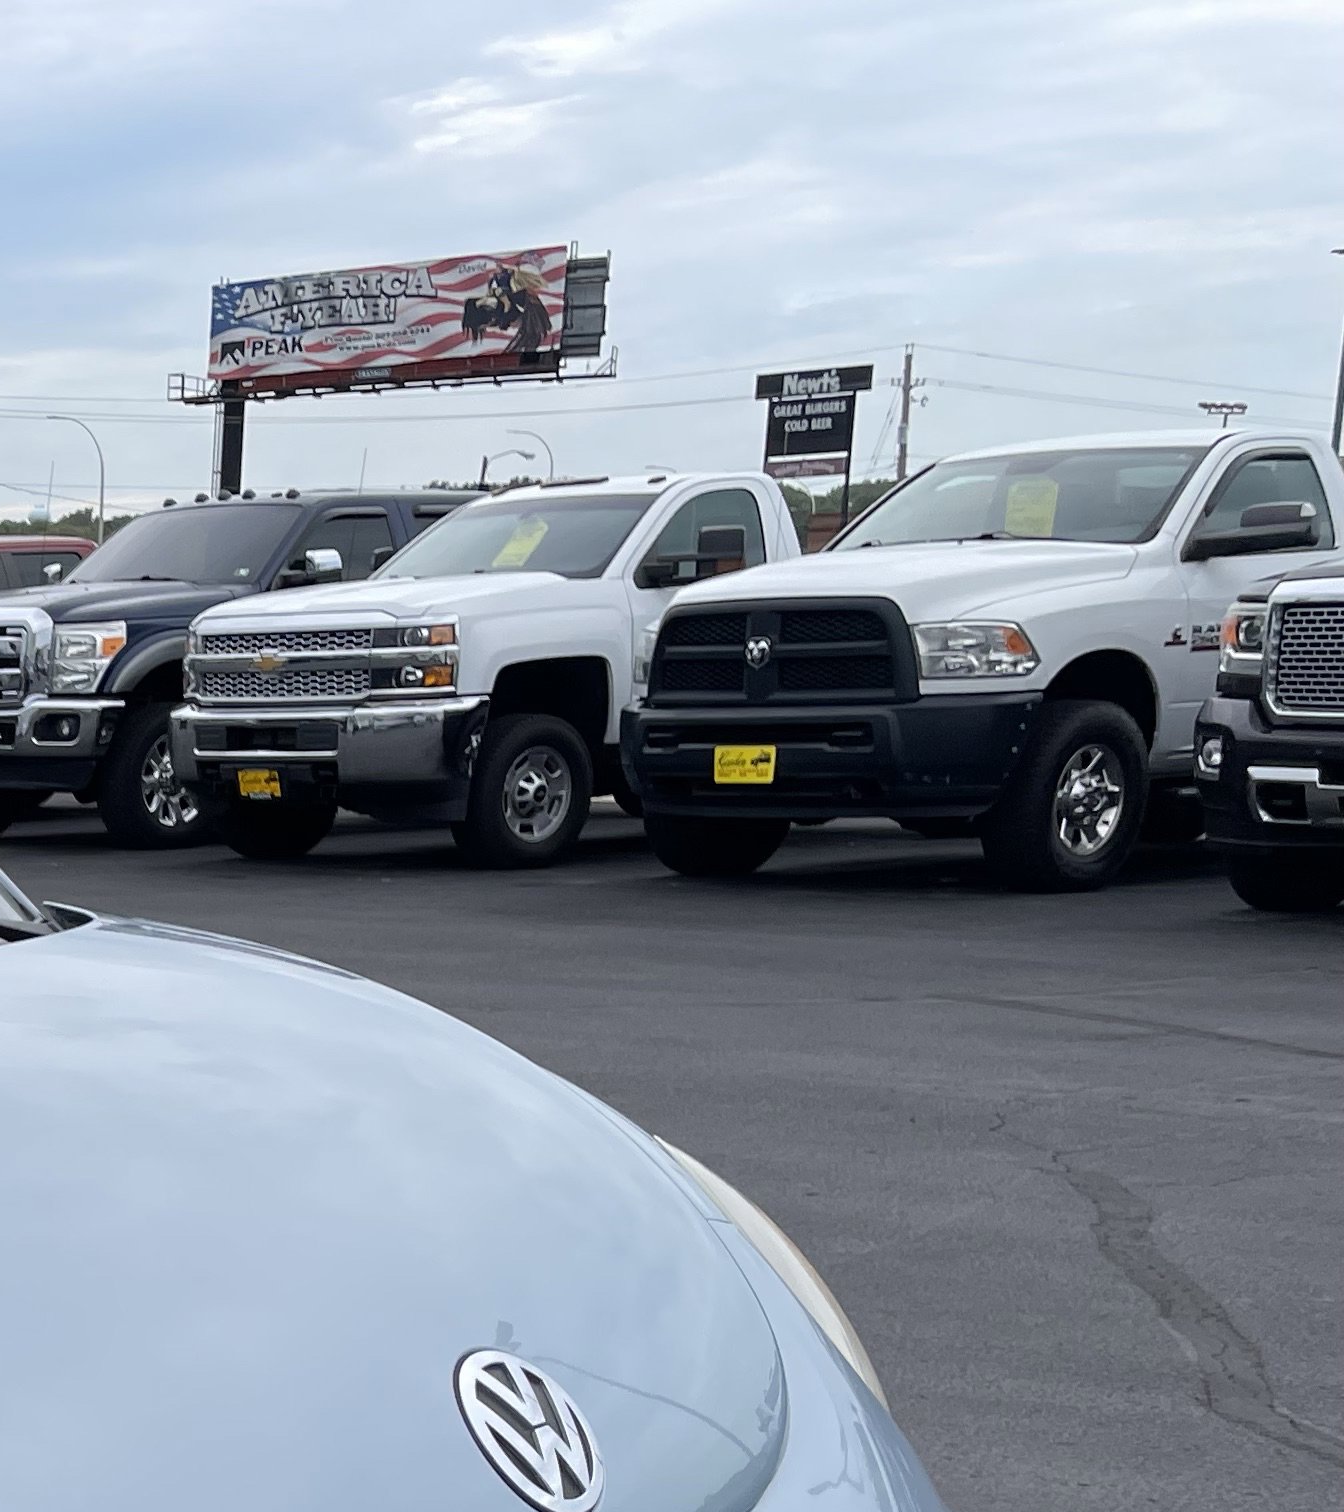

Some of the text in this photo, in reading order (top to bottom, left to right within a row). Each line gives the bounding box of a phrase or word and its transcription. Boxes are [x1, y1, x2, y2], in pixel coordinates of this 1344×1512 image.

[235, 267, 436, 320] AMERICA
[251, 335, 303, 357] PEAK
[773, 400, 847, 418] GREAT BURGERS
[784, 417, 833, 432] COLD BEER
